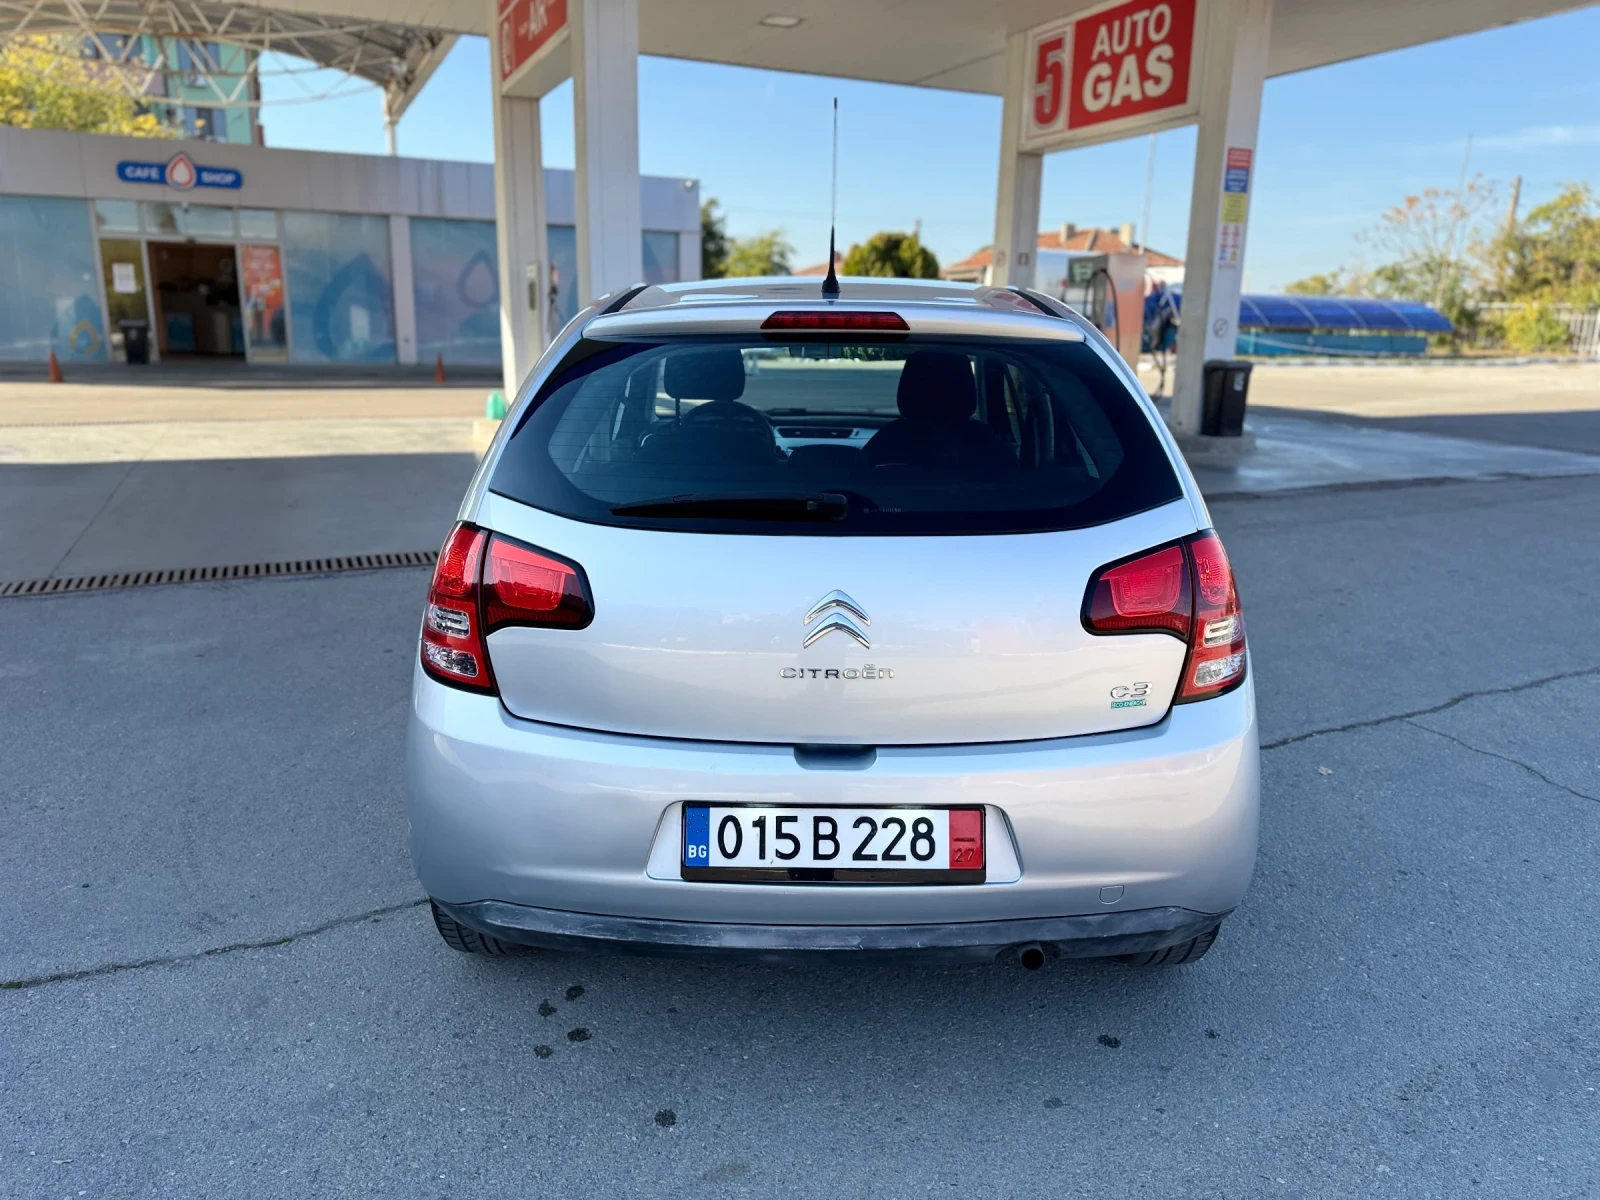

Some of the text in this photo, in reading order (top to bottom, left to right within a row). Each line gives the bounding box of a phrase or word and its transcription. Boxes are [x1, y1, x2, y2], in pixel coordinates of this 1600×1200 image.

[1091, 3, 1172, 61] AUTO
[1034, 29, 1067, 129] 5
[1082, 43, 1175, 113] GAS
[201, 171, 236, 185] SHOP
[1110, 681, 1153, 699] C3
[688, 845, 707, 858] BG
[953, 847, 975, 862] 27
